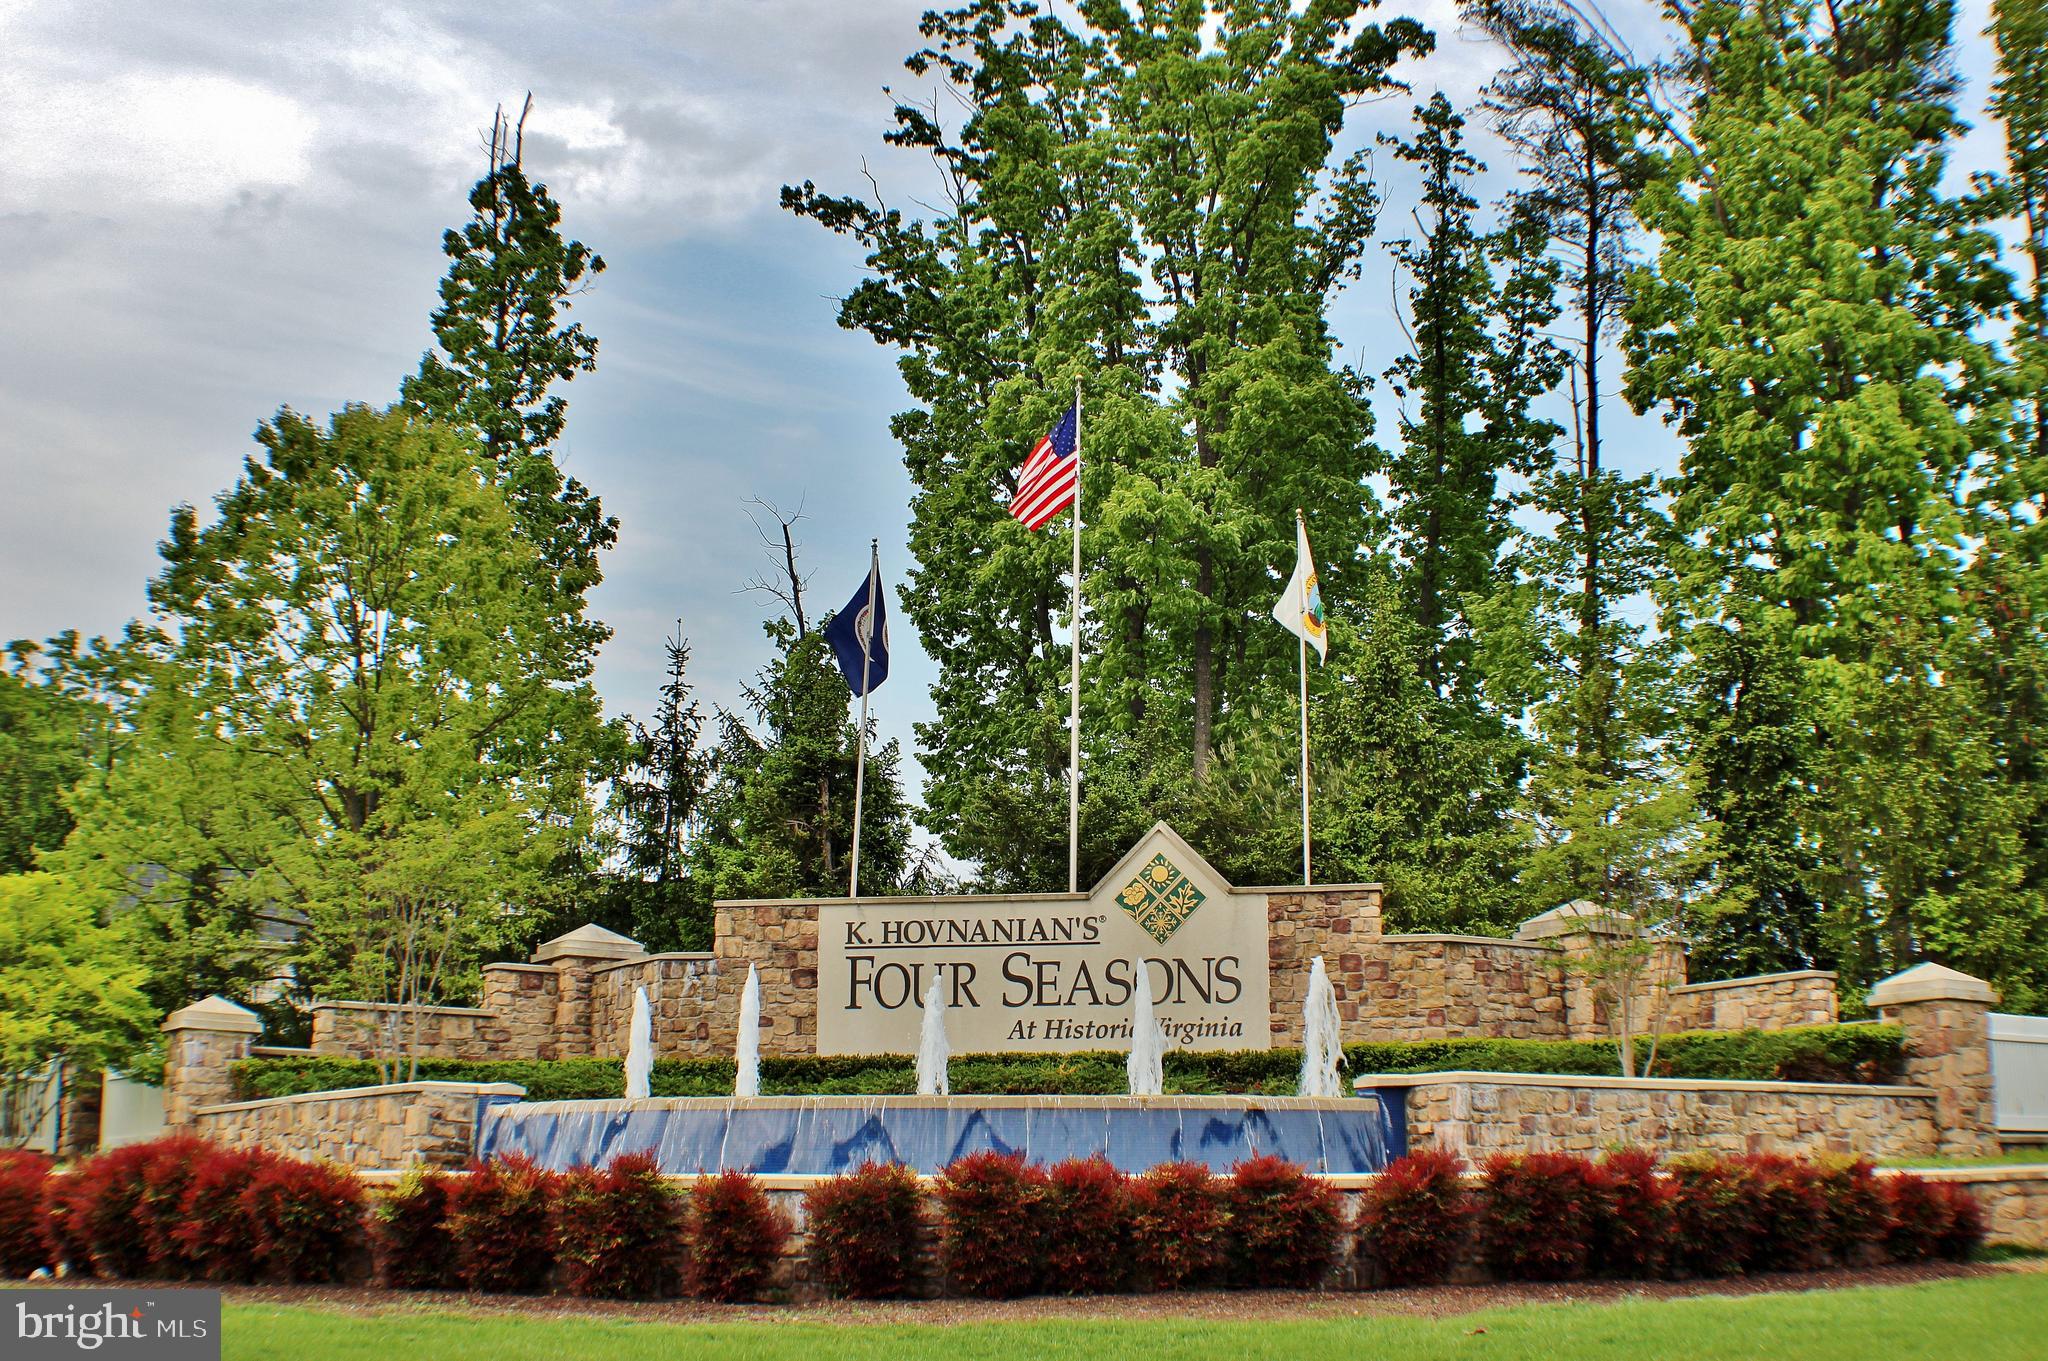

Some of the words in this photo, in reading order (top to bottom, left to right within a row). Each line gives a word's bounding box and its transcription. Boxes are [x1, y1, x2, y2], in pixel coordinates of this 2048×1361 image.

[845, 921, 873, 944] K.
[844, 955, 981, 1010] FOUR
[1001, 952, 1242, 1008] SEASONS
[1007, 1019, 1037, 1040] At
